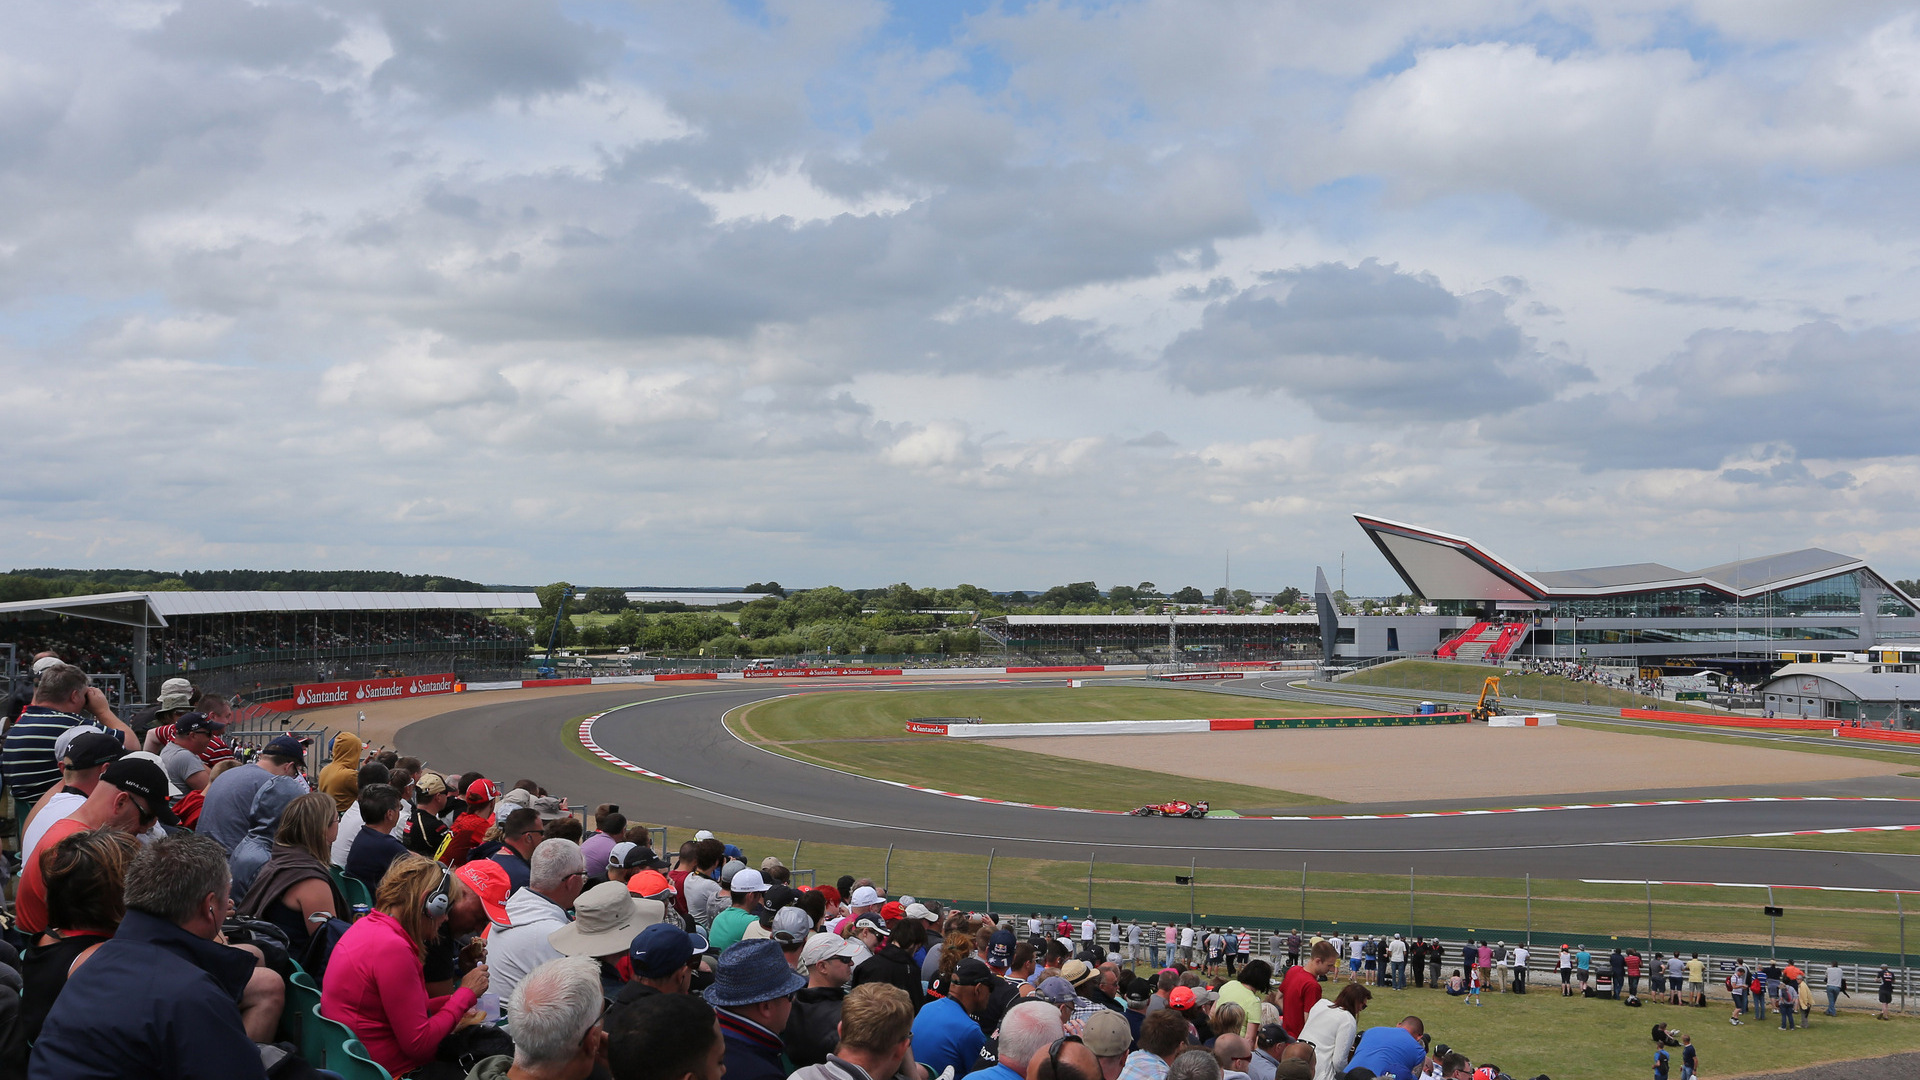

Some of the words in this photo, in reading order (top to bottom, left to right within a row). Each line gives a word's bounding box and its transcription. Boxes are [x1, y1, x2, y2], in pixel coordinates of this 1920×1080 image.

[365, 682, 404, 698] Santander
[417, 677, 452, 693] Santander
[306, 686, 349, 704] Santander
[916, 725, 945, 733] Santander
[464, 864, 489, 891] LEWIS
